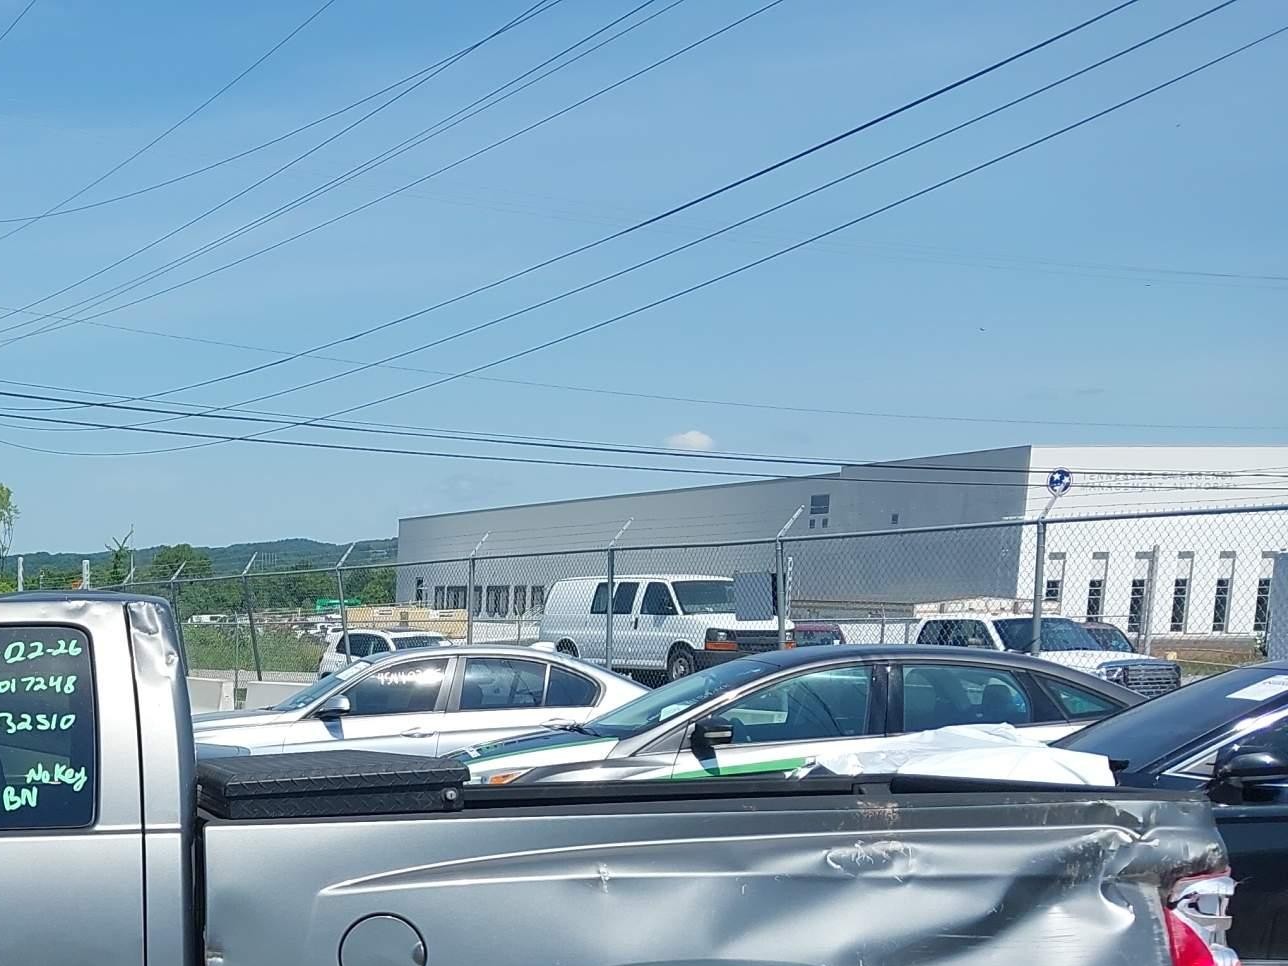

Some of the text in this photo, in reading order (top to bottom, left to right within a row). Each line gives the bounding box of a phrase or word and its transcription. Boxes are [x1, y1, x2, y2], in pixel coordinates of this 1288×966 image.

[25, 763, 88, 792] No Key
[2, 785, 38, 811] BN
